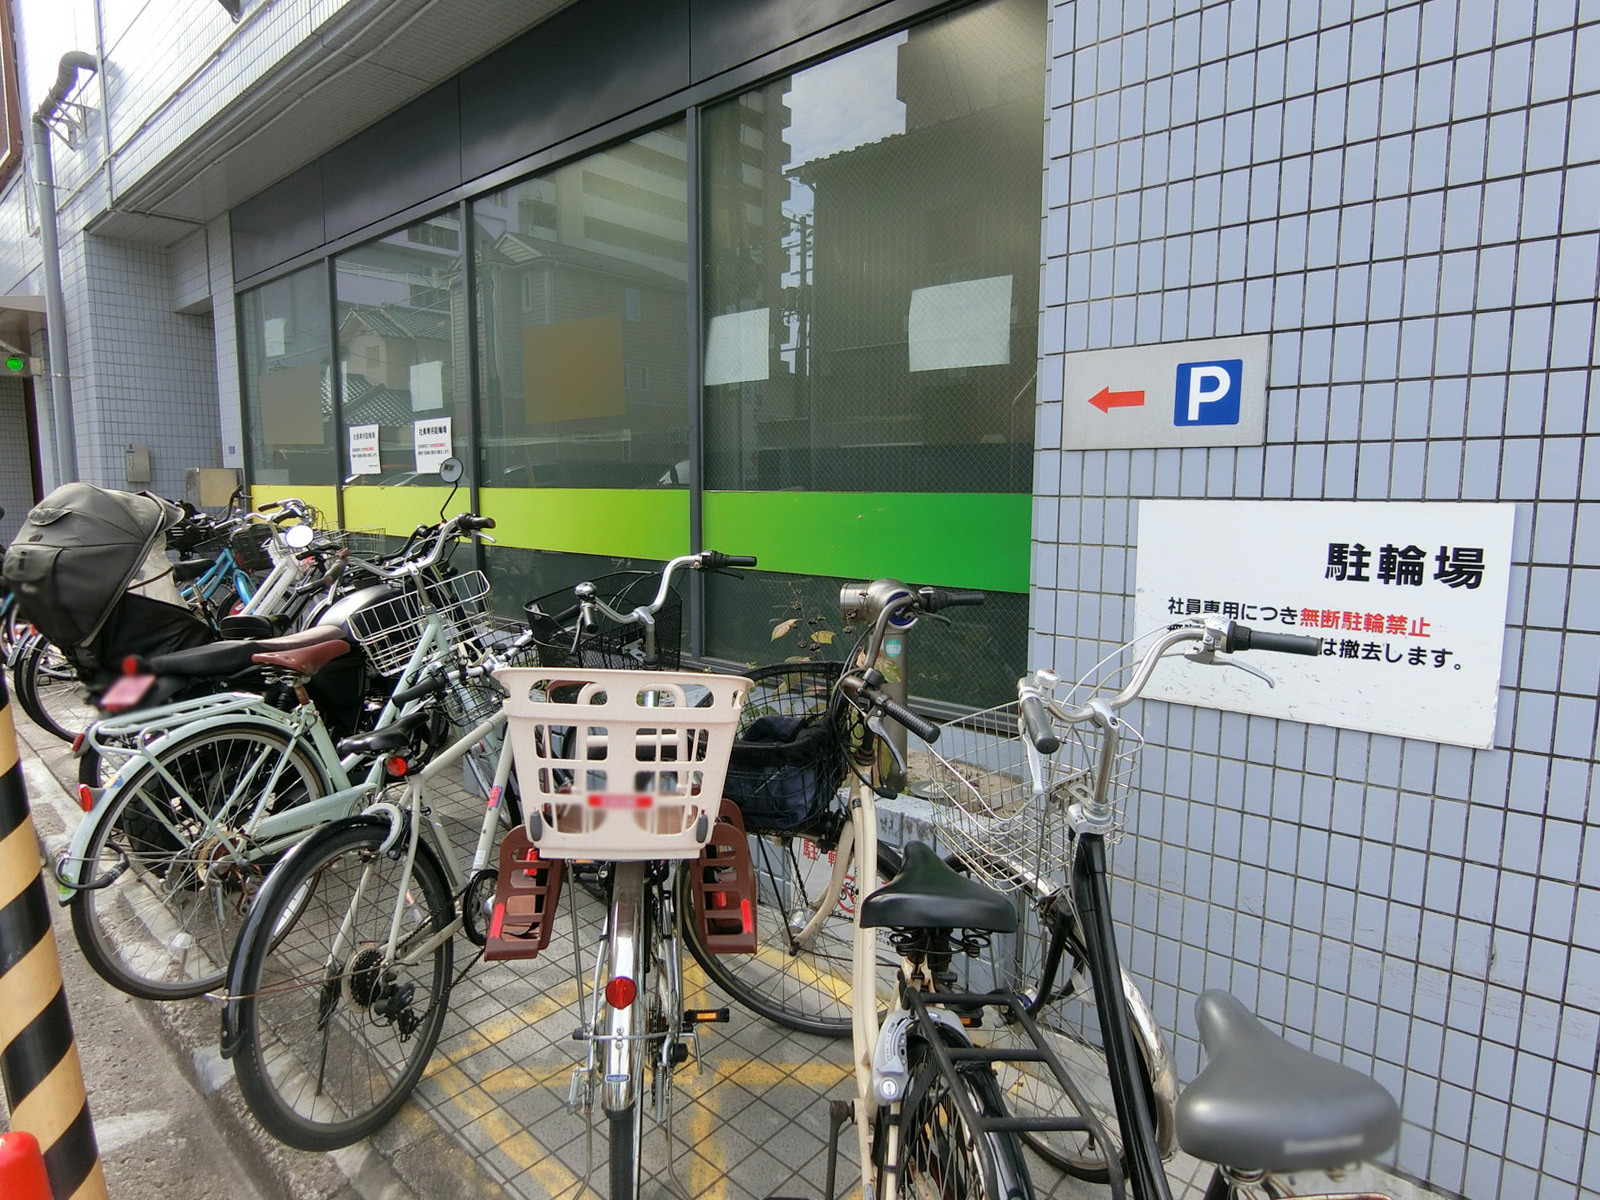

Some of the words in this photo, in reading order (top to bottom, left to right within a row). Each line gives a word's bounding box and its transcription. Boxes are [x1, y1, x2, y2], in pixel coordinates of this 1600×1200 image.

[1187, 366, 1231, 421] P
[1324, 542, 1486, 590] 駐輪場
